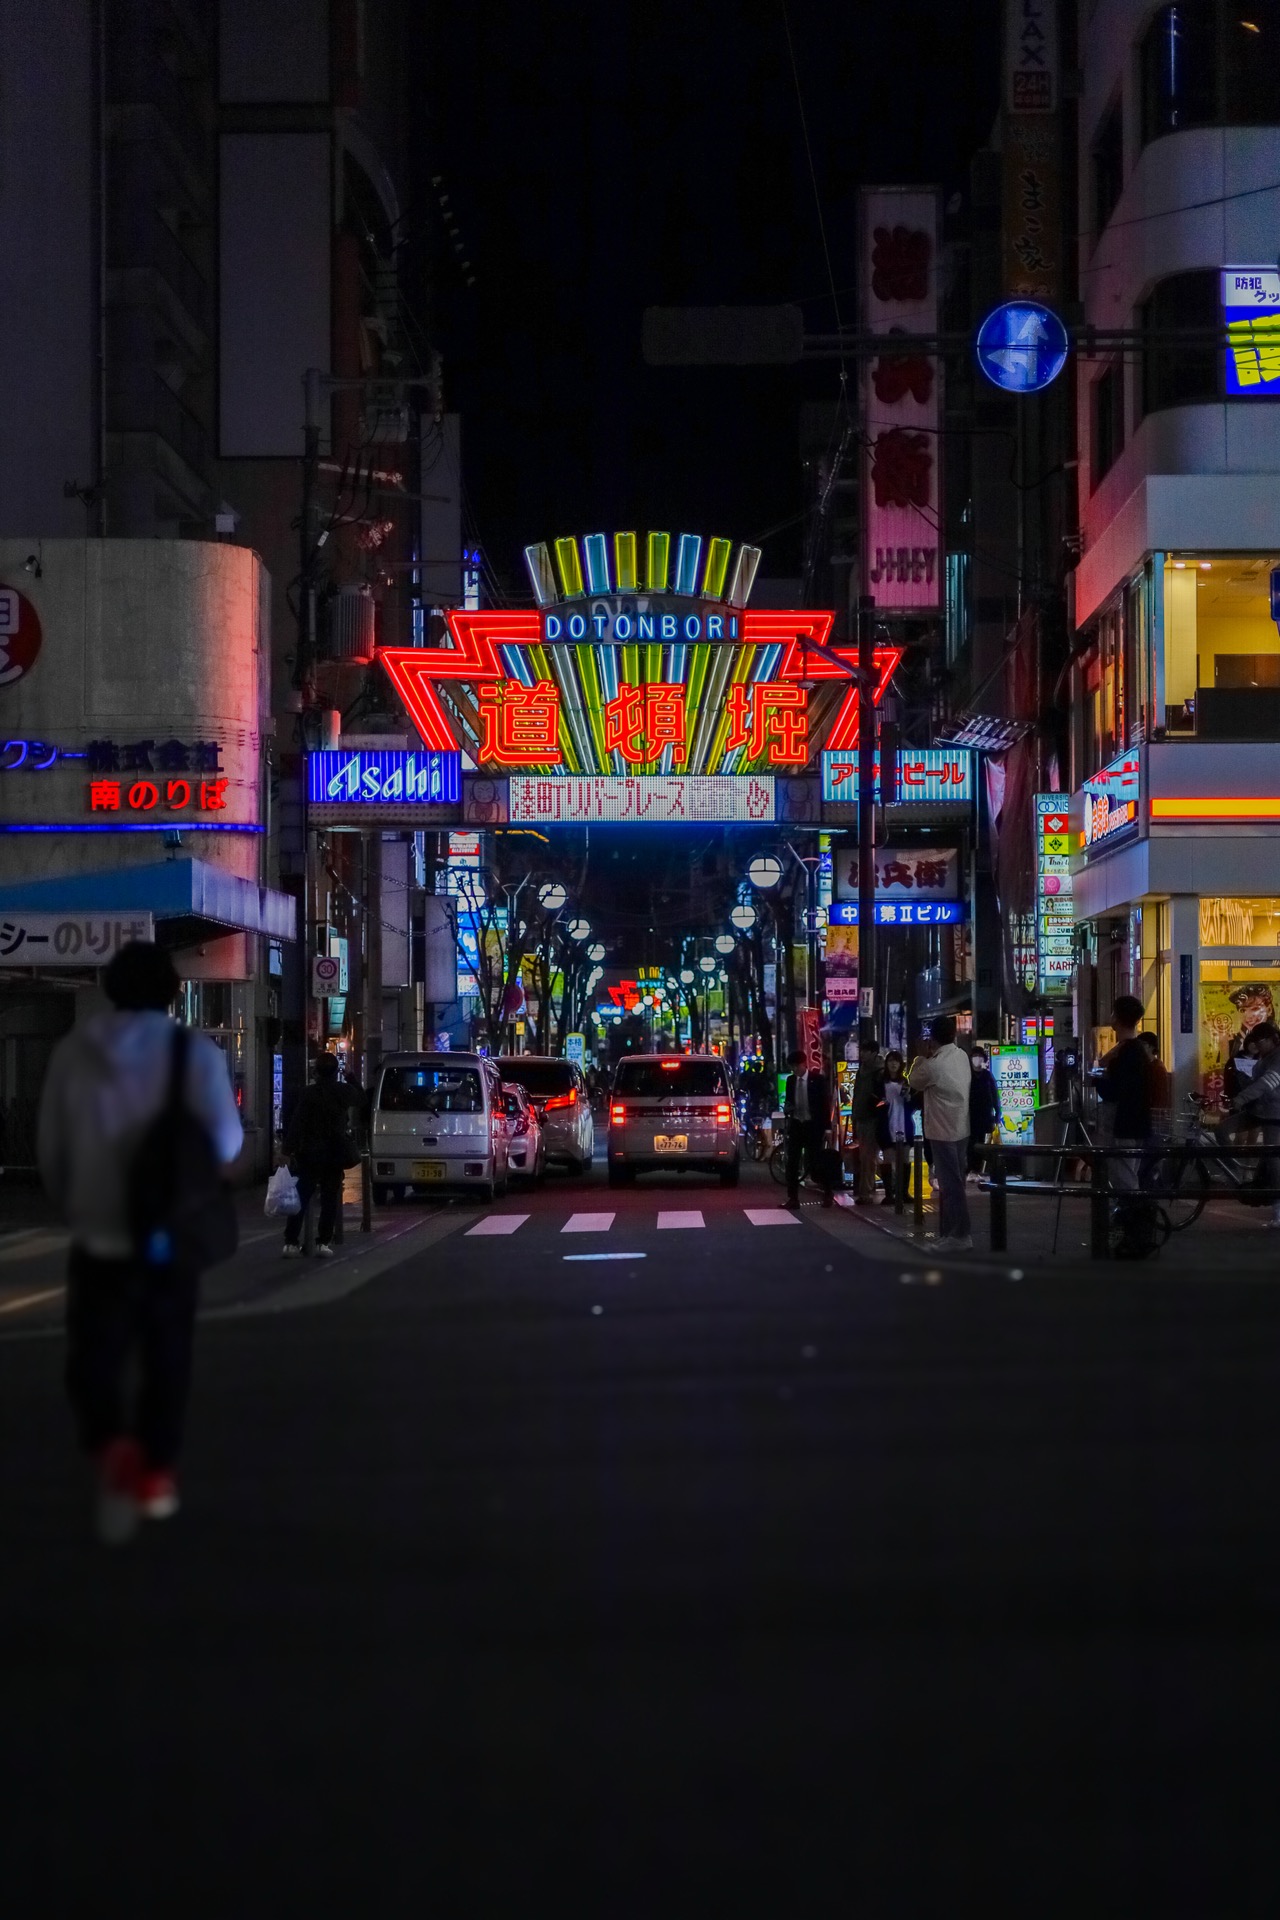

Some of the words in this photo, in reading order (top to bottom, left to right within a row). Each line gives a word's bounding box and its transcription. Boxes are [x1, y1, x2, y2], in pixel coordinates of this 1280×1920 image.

[1235, 277, 1263, 290] 防犯
[545, 614, 738, 640] DOTONBORI
[478, 679, 809, 767] 道頓堀
[327, 752, 441, 798] Asahi
[90, 779, 228, 811] 南のりば
[841, 905, 951, 922] 中第Ⅱビル
[320, 964, 333, 975] 30
